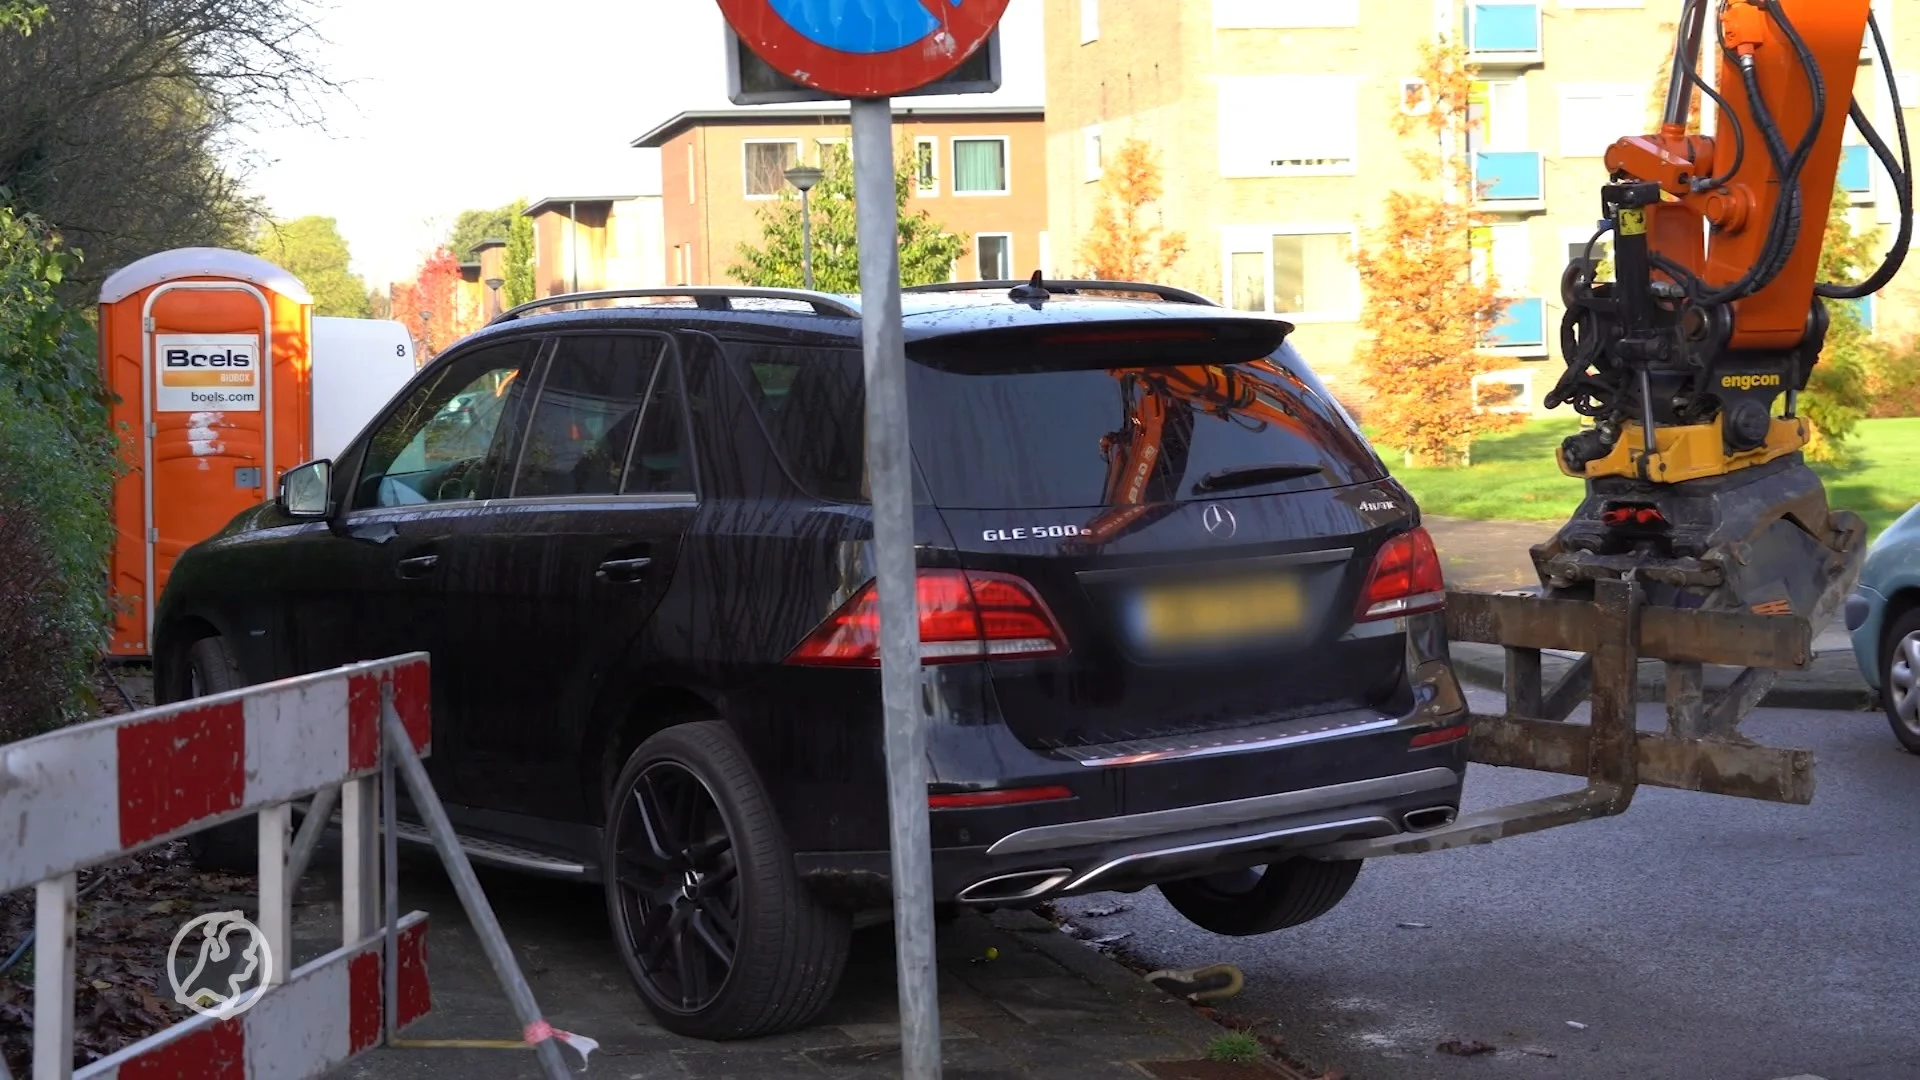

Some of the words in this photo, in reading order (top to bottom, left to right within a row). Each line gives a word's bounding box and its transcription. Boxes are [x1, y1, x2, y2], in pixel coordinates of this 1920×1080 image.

[396, 344, 406, 357] 8
[1721, 374, 1780, 391] engcon
[191, 391, 255, 402] boels.com
[983, 527, 1028, 541] GLE
